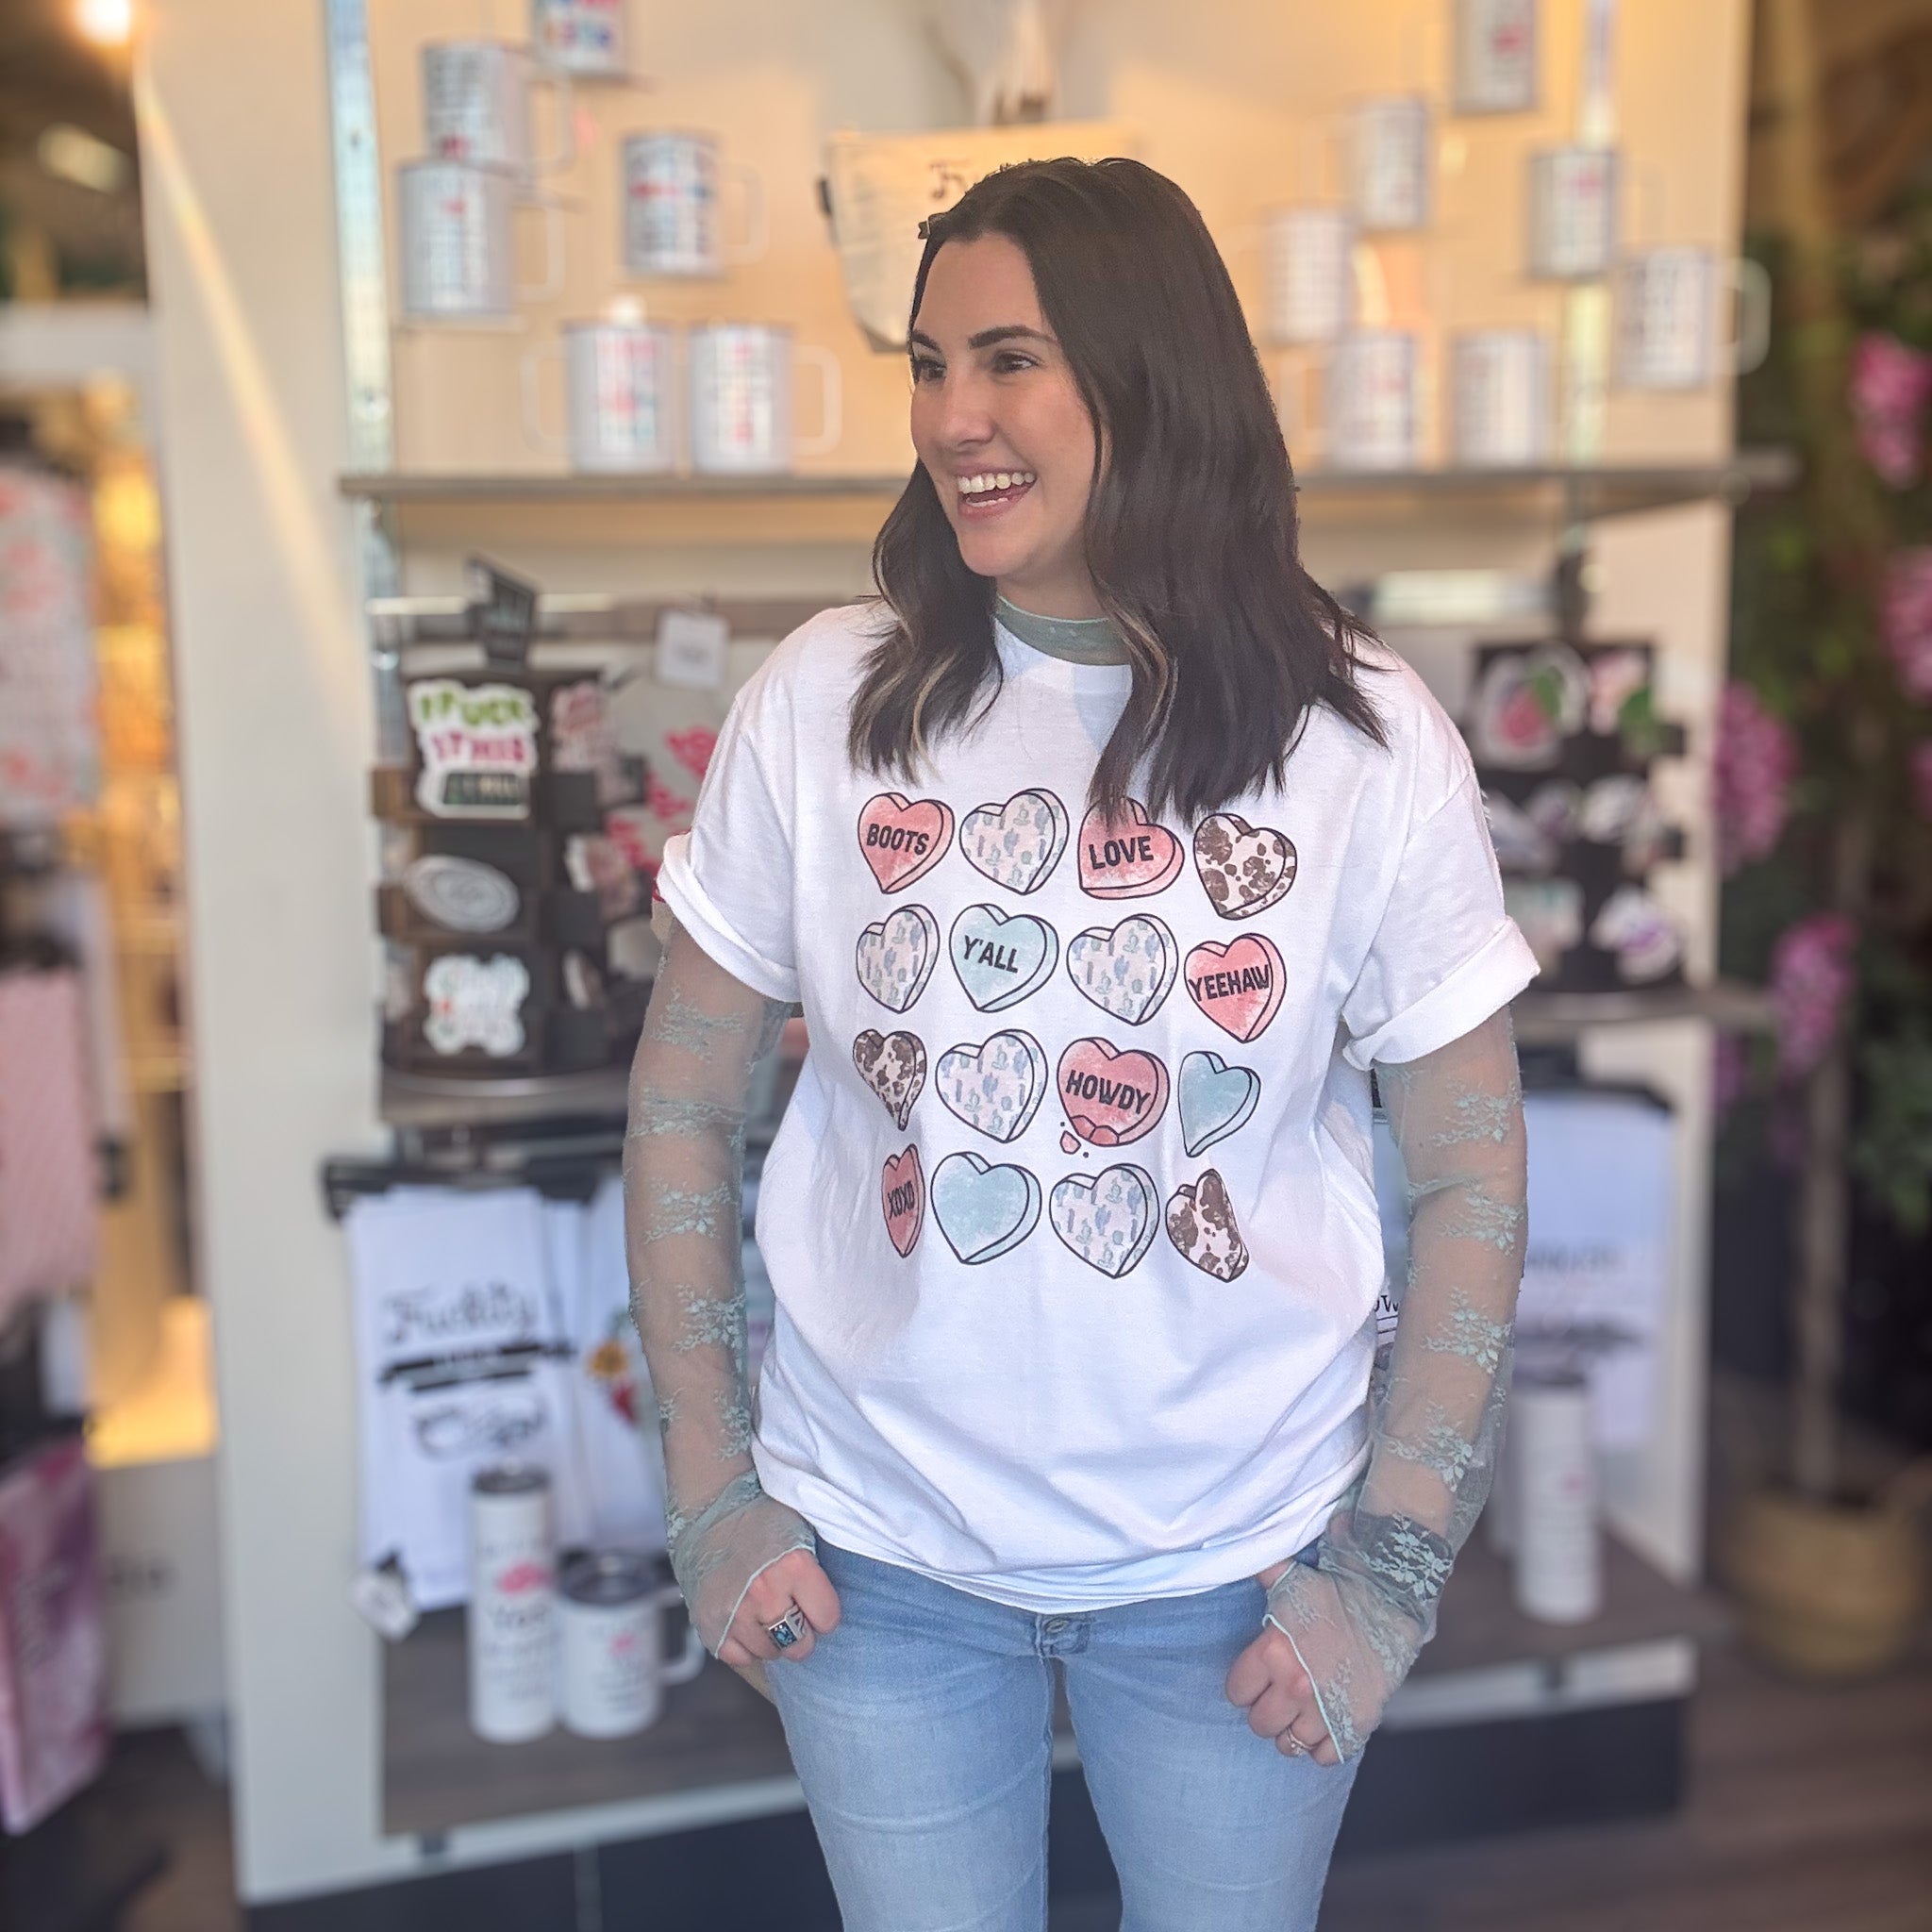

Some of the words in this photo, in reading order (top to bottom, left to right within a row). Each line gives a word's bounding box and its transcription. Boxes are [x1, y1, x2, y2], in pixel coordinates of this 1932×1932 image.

[866, 823, 930, 856] BOOTS
[1088, 835, 1155, 870] LOVE
[963, 934, 1019, 974] Y'ALL
[1187, 963, 1270, 1003] YEEHAW
[1065, 1068, 1152, 1115] HOWDY
[887, 1179, 915, 1221] XOXO
